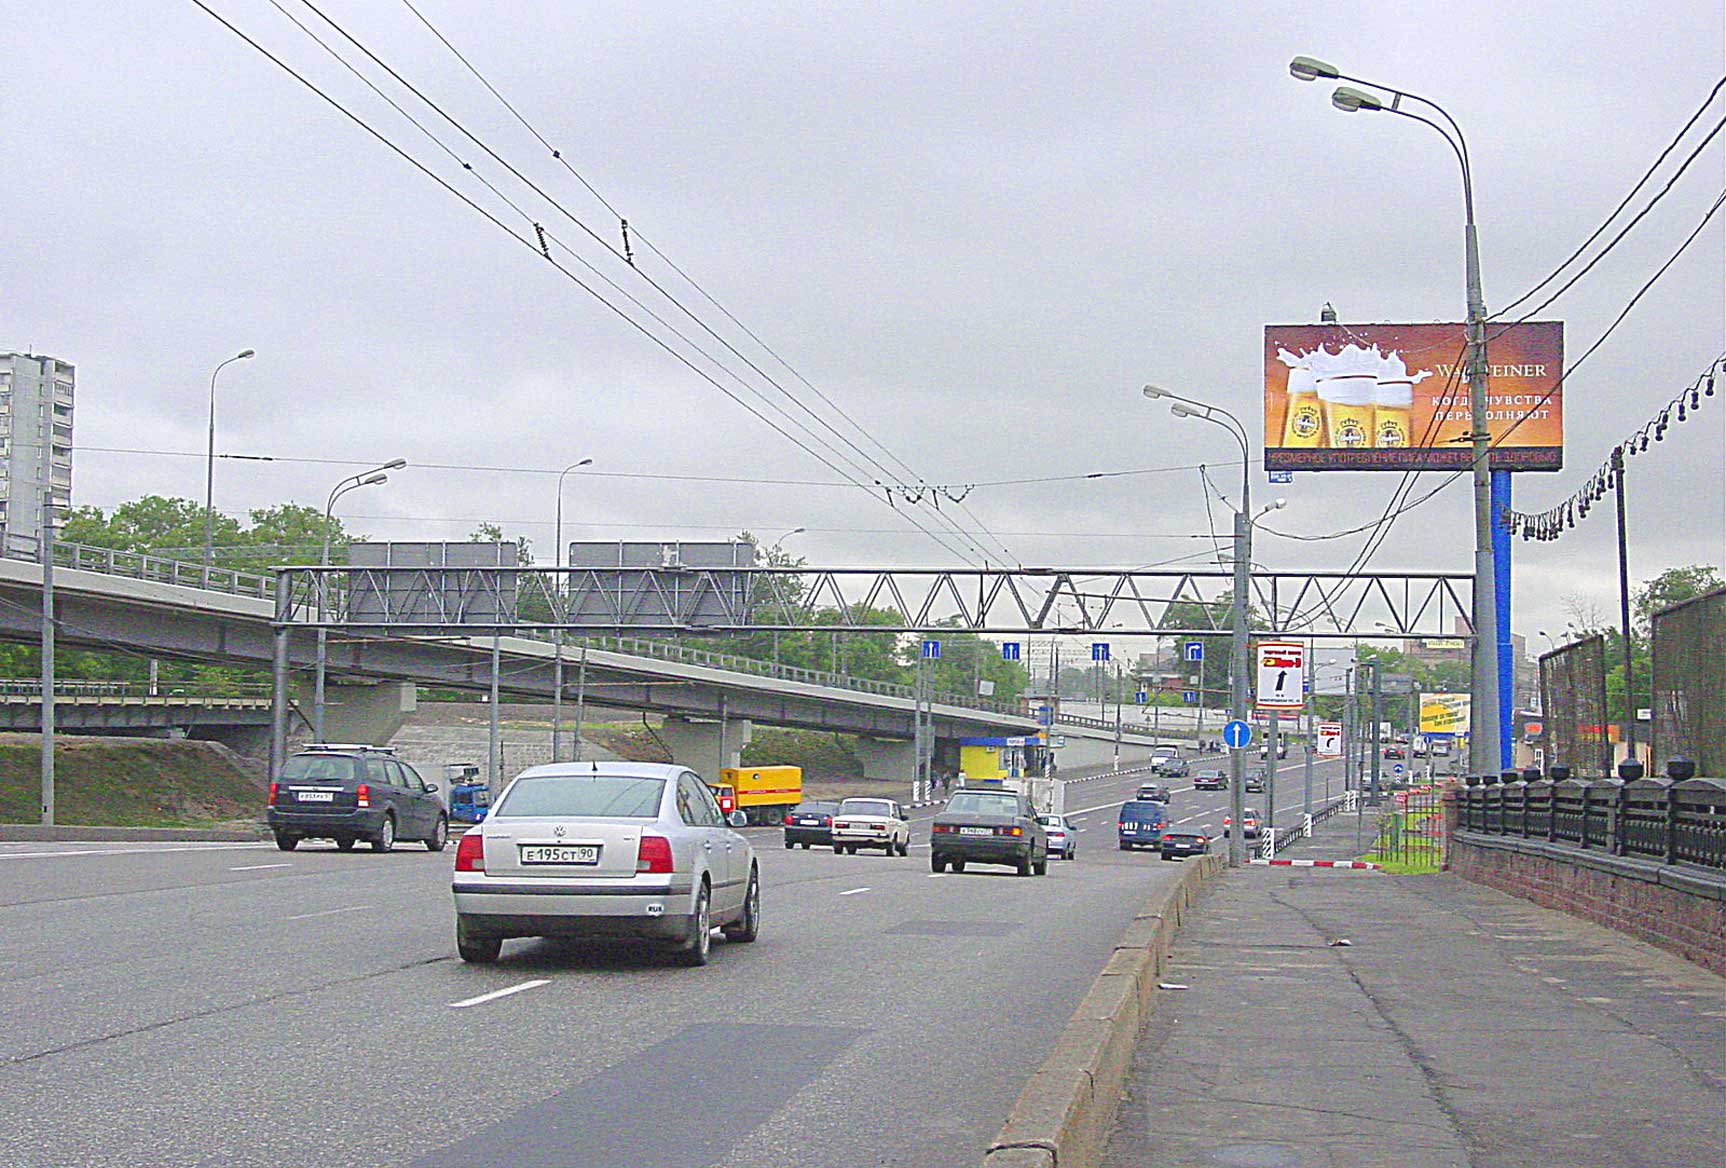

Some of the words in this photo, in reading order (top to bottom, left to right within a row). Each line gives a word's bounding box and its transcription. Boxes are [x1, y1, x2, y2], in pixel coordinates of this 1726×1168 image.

[1436, 364, 1548, 377] WAEINER
[1432, 396, 1472, 406] КОГД
[1434, 410, 1550, 421] ПЕРЕОЛНЯЮТ
